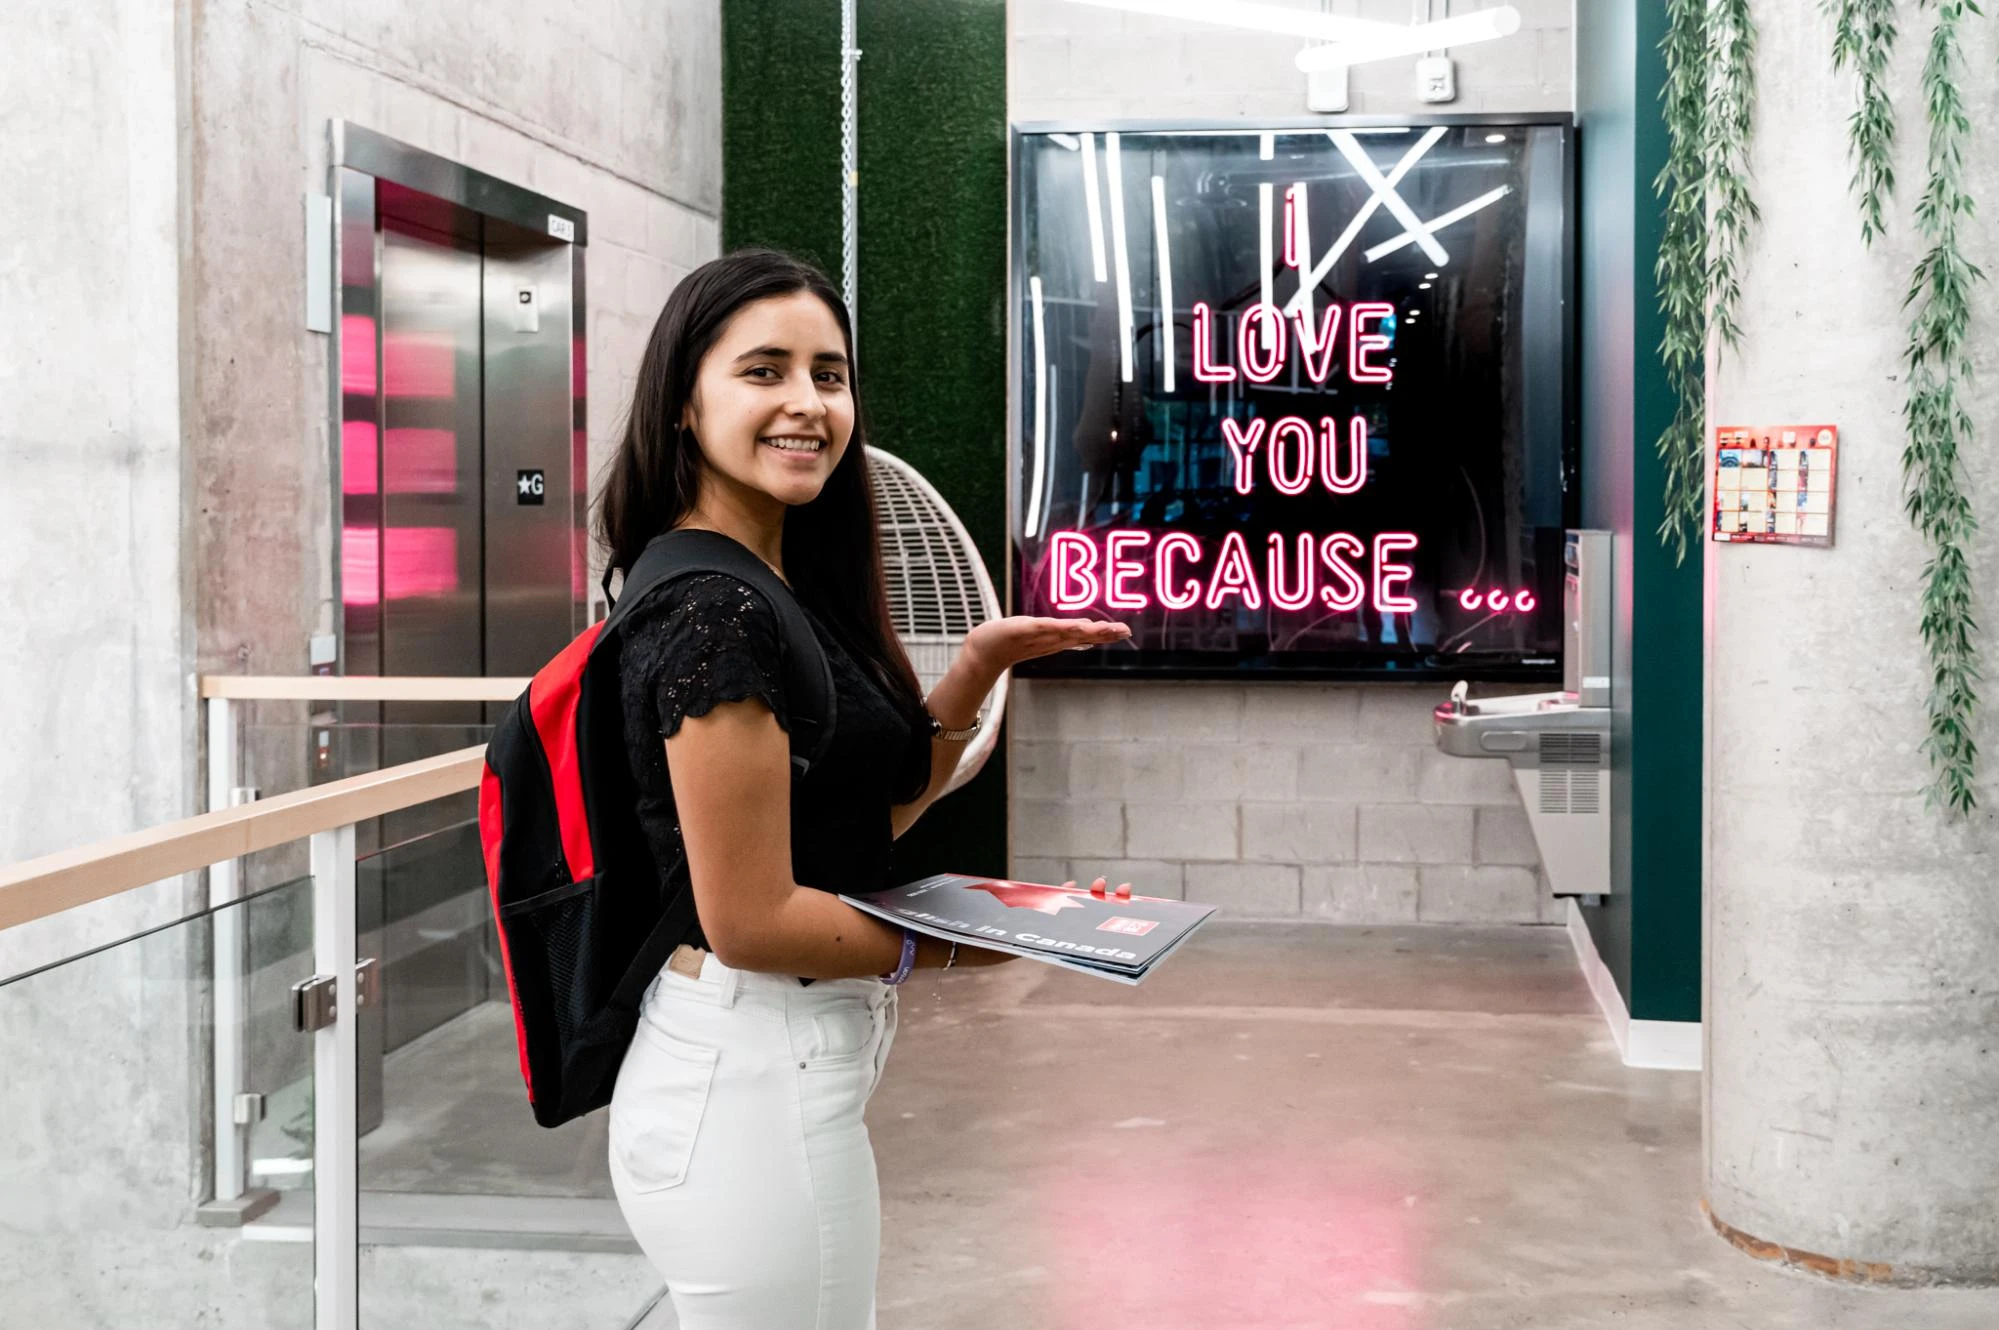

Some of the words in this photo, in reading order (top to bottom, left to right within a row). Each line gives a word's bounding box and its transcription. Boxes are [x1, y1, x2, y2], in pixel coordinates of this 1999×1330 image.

[1193, 302, 1395, 382] LOVE
[1221, 415, 1367, 494] YOU
[1050, 530, 1418, 612] BECAUSE
[1015, 933, 1136, 959] Canada
